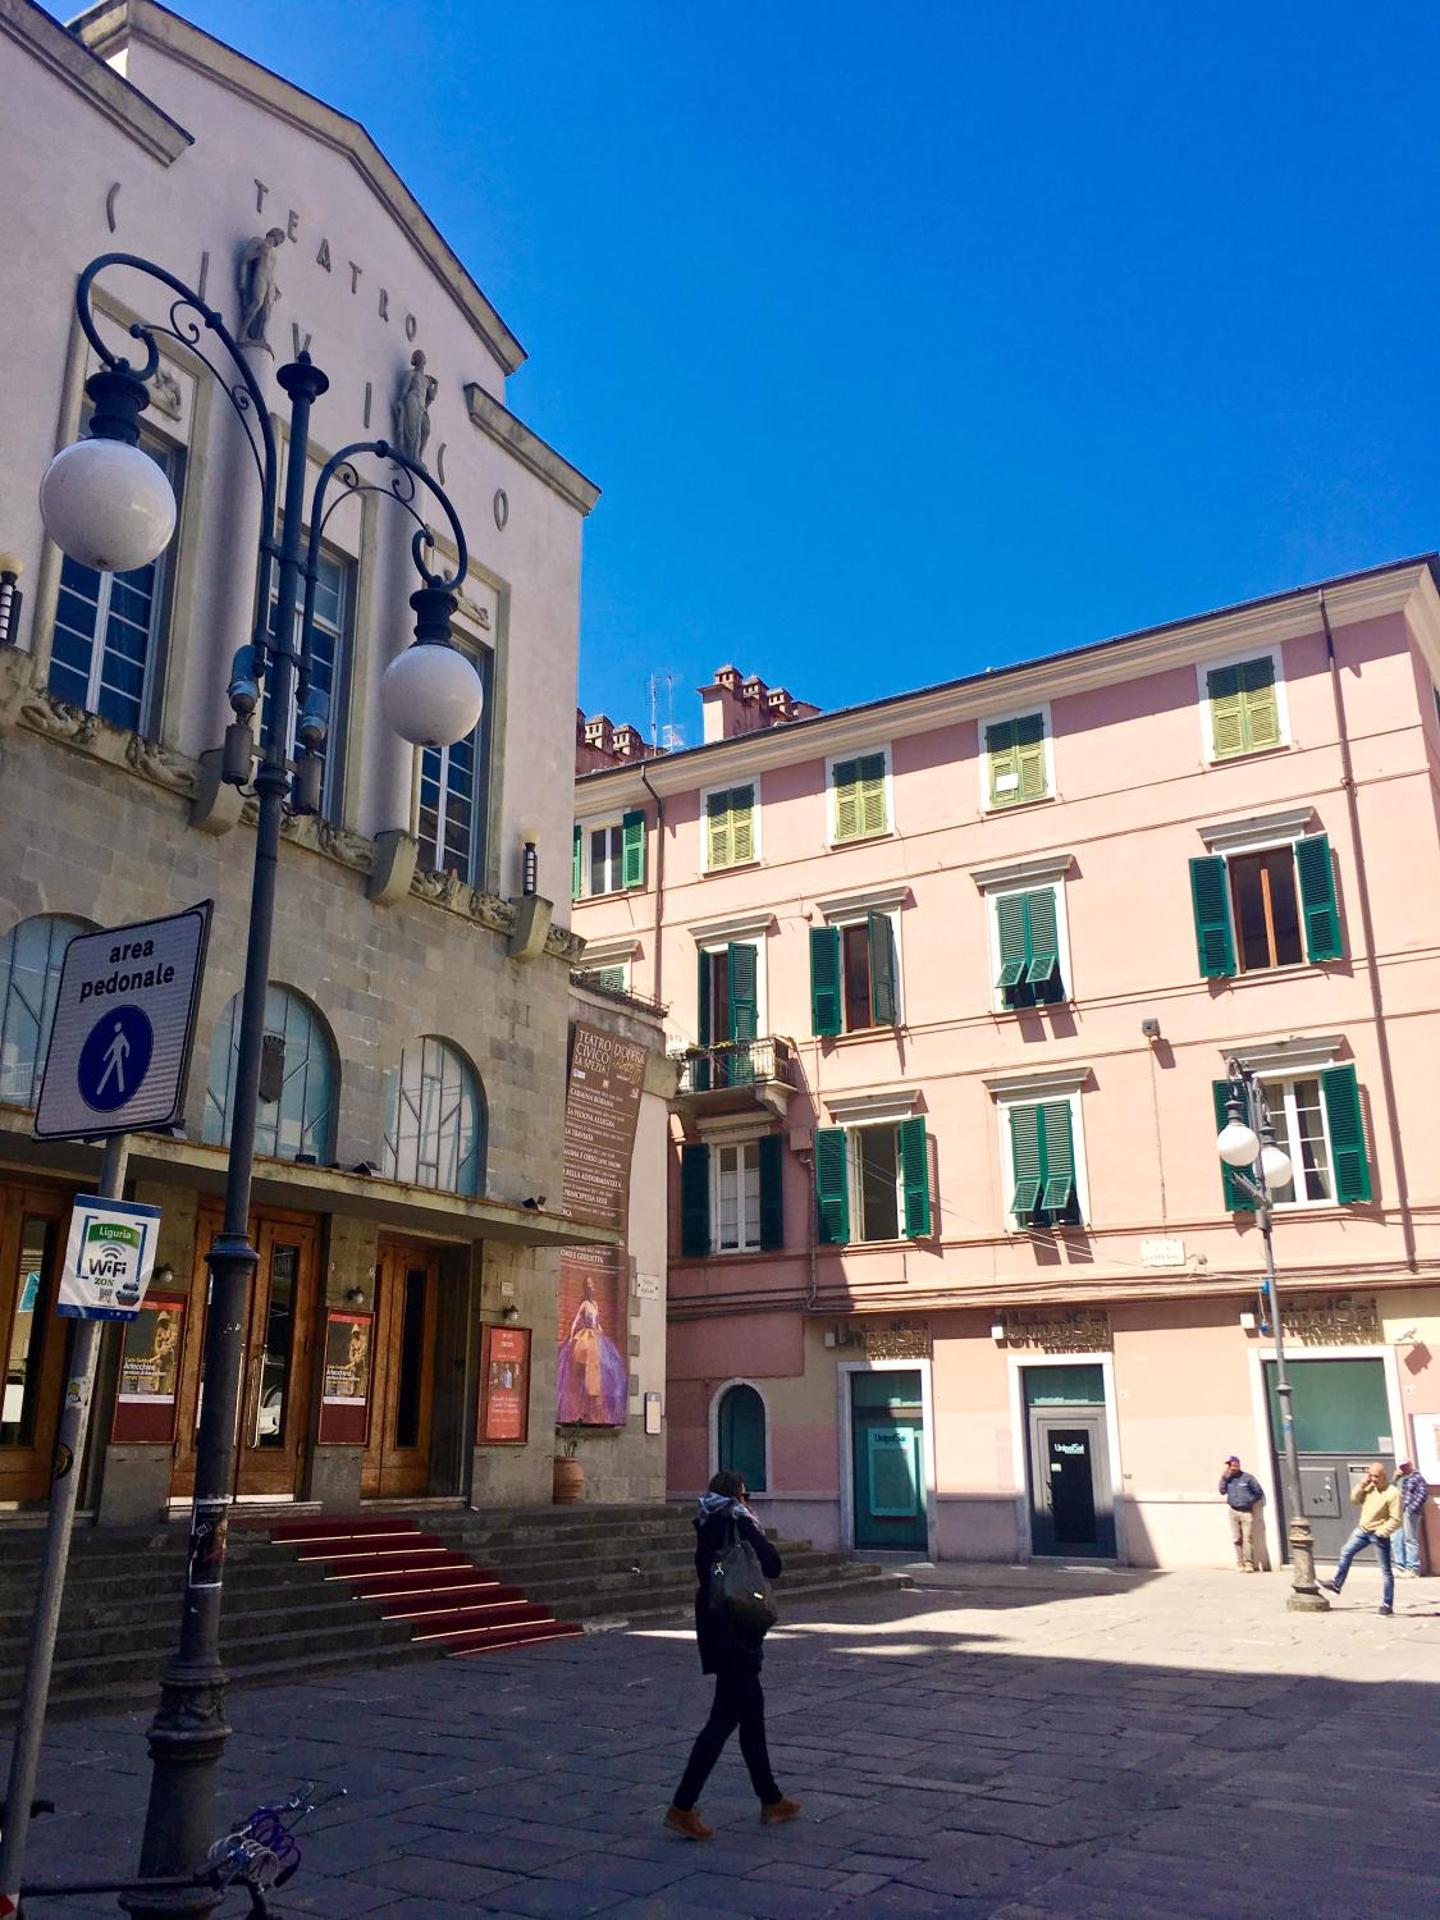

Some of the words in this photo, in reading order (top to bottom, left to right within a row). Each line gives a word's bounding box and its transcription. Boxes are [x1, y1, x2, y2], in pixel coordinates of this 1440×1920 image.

[254, 178, 417, 342] TEATRO
[109, 939, 154, 963] area
[79, 962, 175, 1003] pedonale
[579, 1030, 612, 1052] TEATRO
[576, 1043, 609, 1065] CIVICO
[99, 1226, 131, 1239] Liguria
[89, 1258, 127, 1278] WiFi
